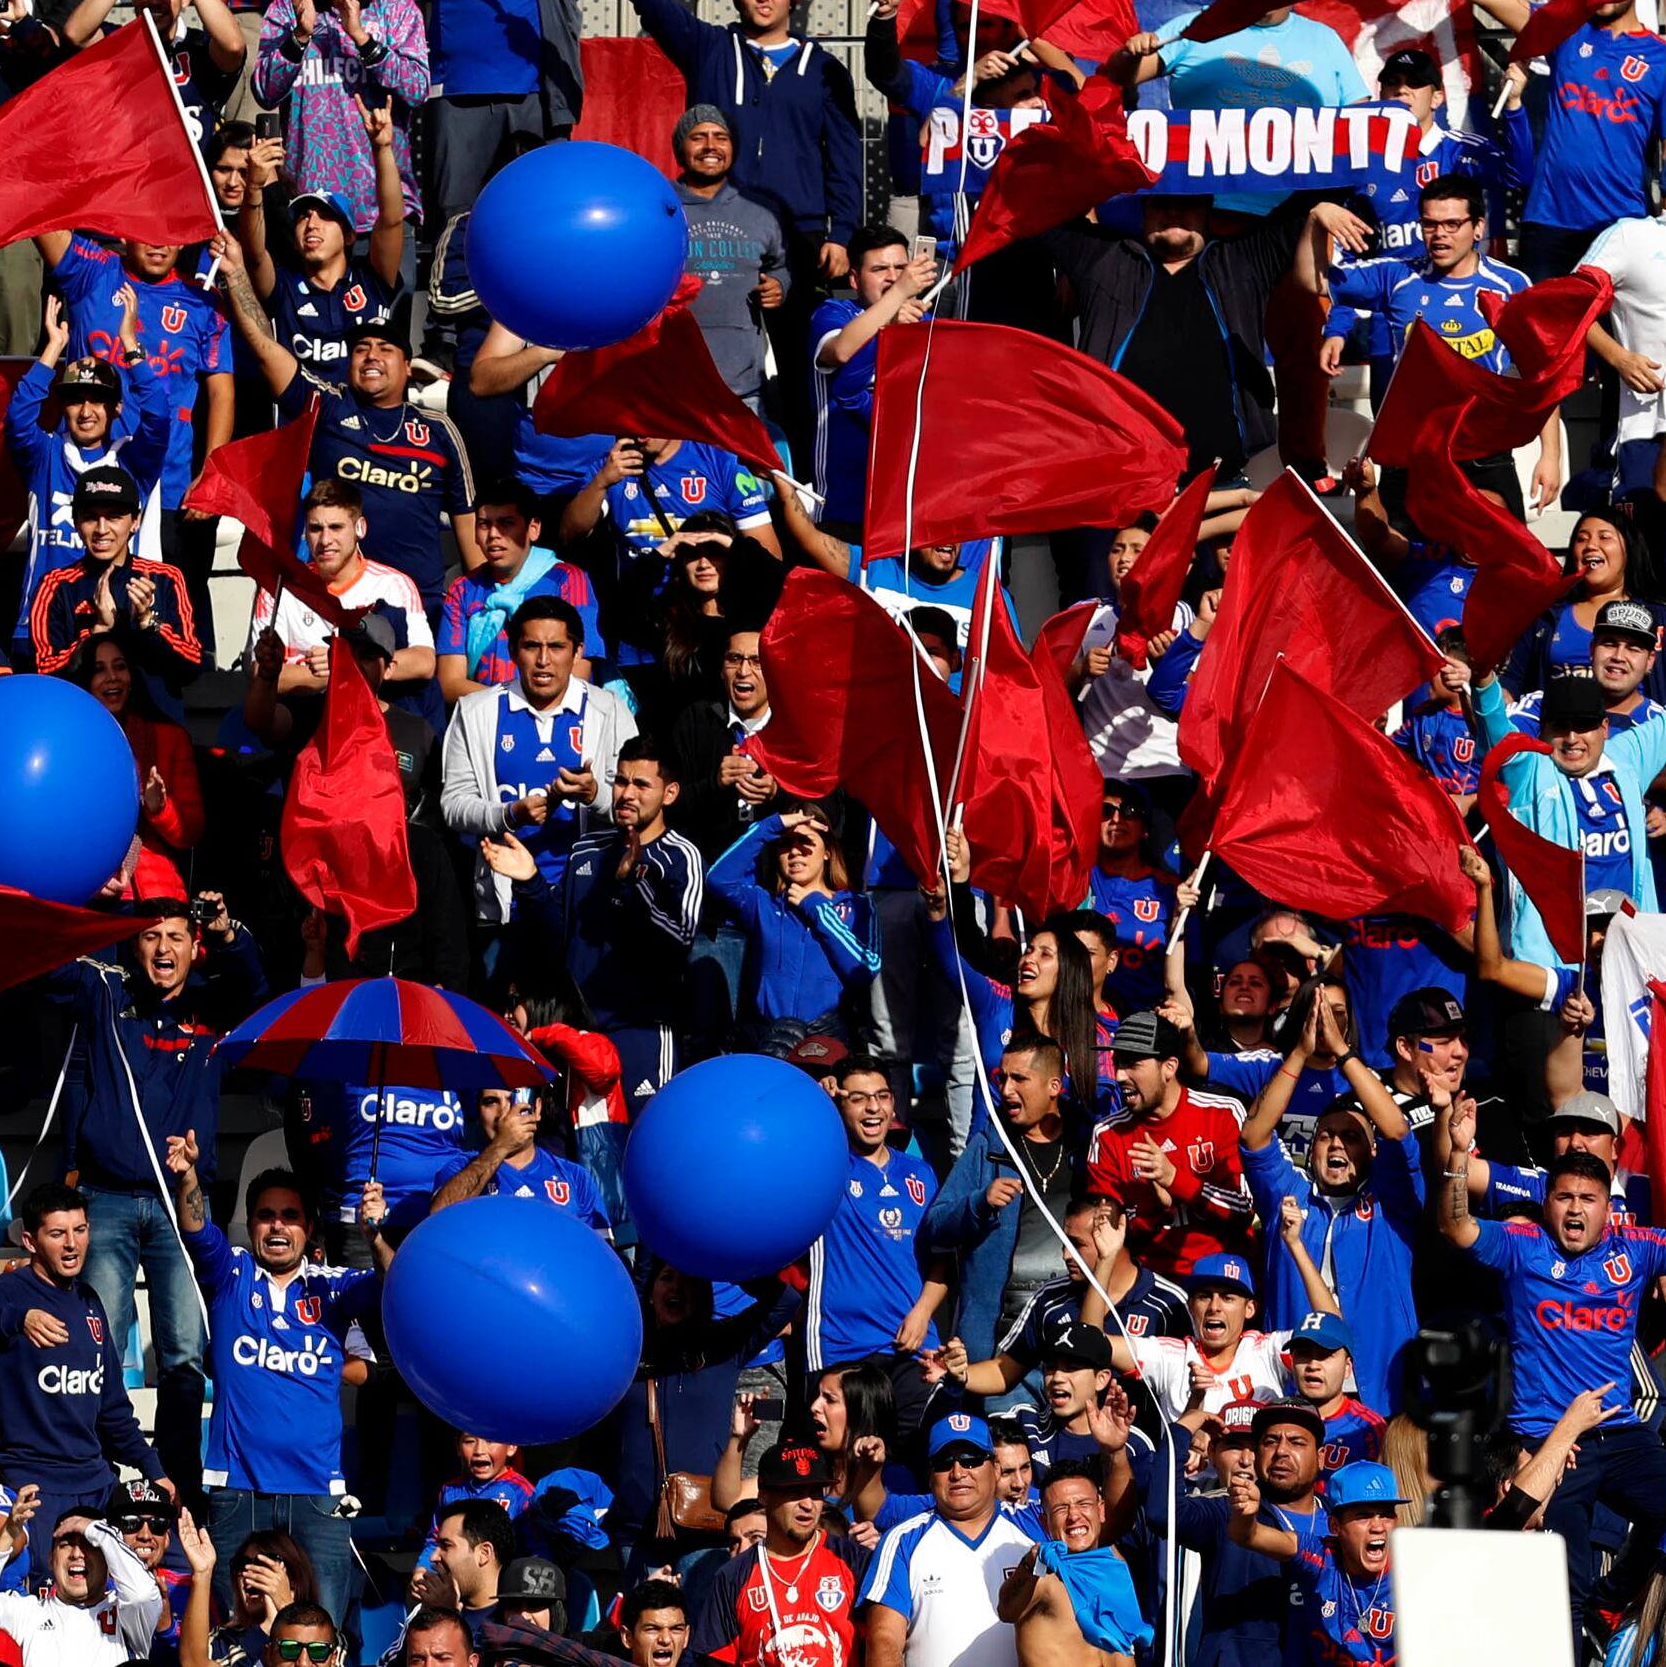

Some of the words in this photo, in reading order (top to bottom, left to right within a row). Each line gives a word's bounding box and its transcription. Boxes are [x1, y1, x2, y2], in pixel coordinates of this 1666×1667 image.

[1619, 54, 1650, 83] U
[1559, 83, 1624, 124] Claro
[1188, 106, 1418, 178] MONTT
[342, 284, 367, 312] U
[161, 305, 187, 334] U
[293, 334, 348, 360] Cla
[406, 423, 430, 447] U
[336, 455, 420, 493] Claro
[680, 476, 707, 504] U
[359, 1091, 452, 1131] Claro
[1187, 1143, 1215, 1174] U
[544, 1180, 570, 1206] U
[1603, 1254, 1632, 1285] U
[296, 1296, 322, 1325] U
[1300, 1313, 1326, 1331] H
[1535, 1298, 1625, 1332] Claro
[232, 1335, 321, 1377] Claro
[1227, 1374, 1256, 1402] U
